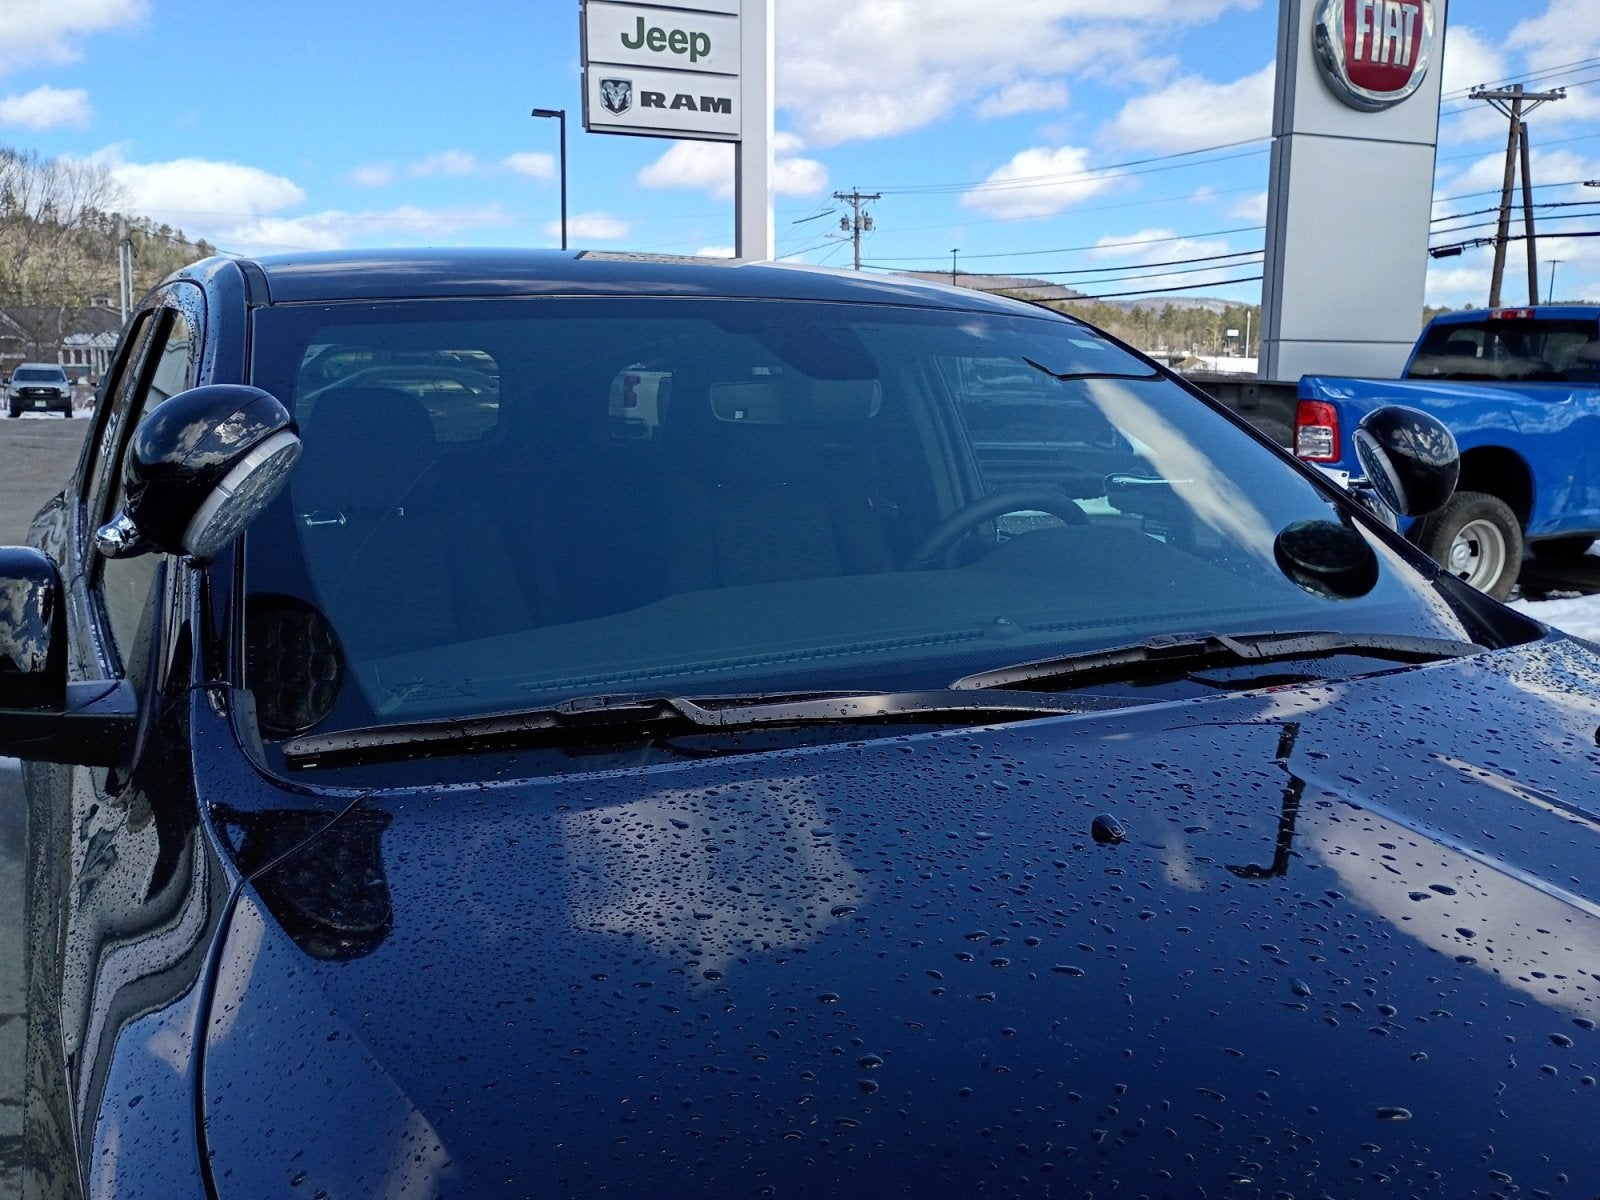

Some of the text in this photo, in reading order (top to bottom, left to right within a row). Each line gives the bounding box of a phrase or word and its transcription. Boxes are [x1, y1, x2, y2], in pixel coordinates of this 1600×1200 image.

[621, 16, 711, 62] Jeep
[1354, 0, 1418, 66] FIAT
[640, 90, 732, 114] RAM
